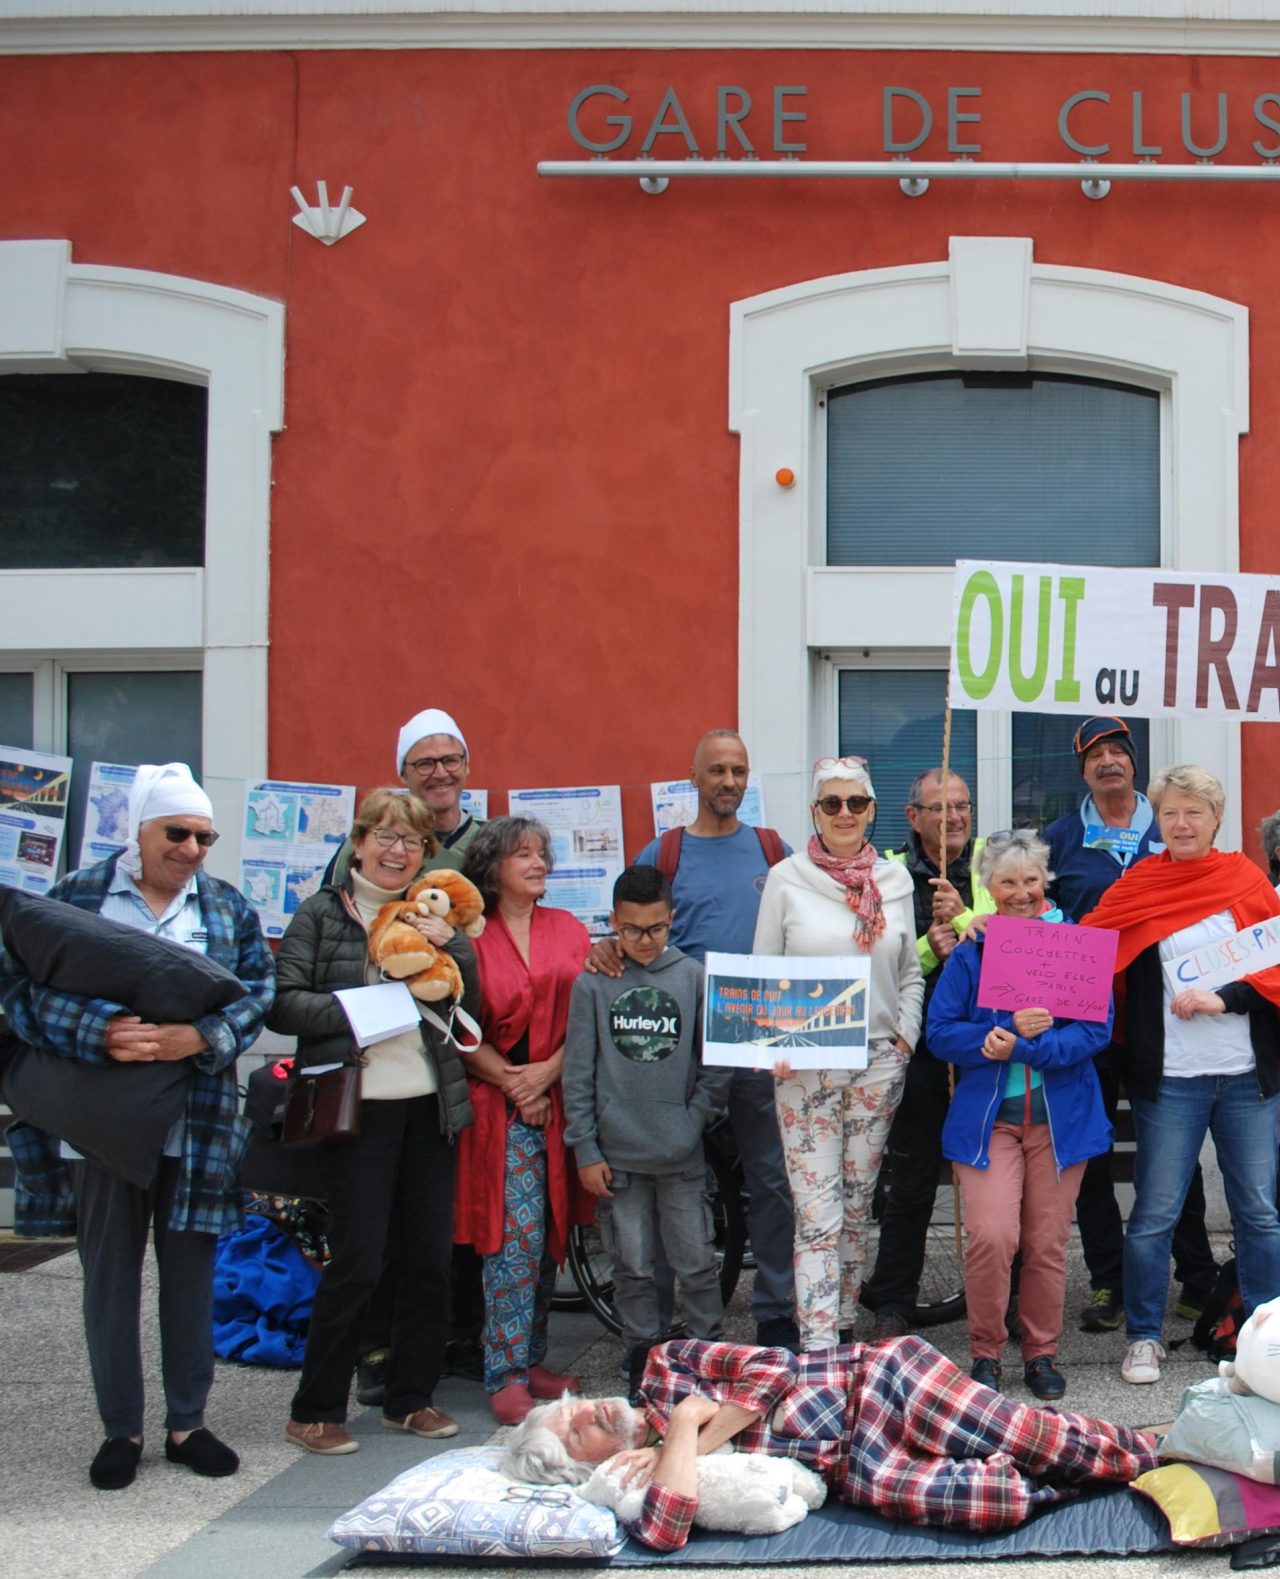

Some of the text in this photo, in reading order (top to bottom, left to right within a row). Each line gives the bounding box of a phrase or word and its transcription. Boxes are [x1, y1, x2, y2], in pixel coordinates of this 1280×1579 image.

[567, 83, 807, 153] GARE
[882, 86, 983, 154] DE
[956, 570, 1086, 703] OUI
[1095, 659, 1139, 706] au
[1024, 926, 1088, 944] TRAIN
[1000, 939, 1097, 964] COUCHETTES
[1026, 969, 1096, 985] VELO ELEC
[718, 987, 782, 1002] TRAINS DE NUIT
[1036, 980, 1077, 994] PARIS
[1014, 993, 1045, 1005] GARE
[1055, 998, 1069, 1007] DE
[613, 1015, 662, 1032] Hurley
